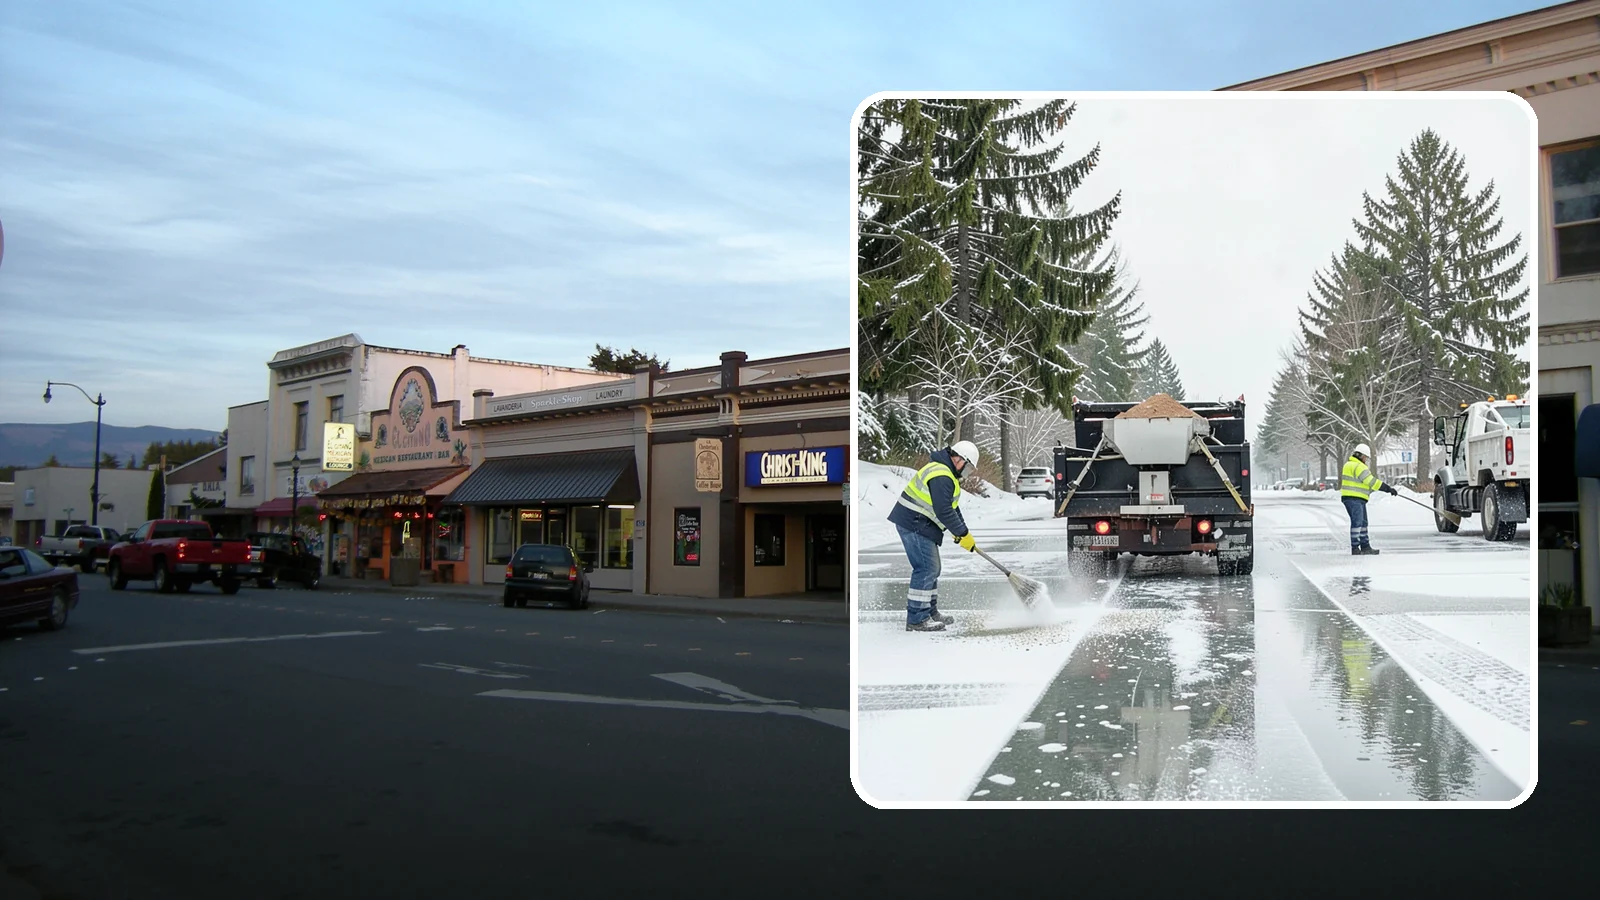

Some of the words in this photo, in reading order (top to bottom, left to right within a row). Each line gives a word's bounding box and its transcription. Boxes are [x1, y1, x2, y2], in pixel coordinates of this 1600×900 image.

[596, 389, 624, 400] LAUNDRY
[493, 402, 523, 412] LAVANDERIA
[530, 397, 561, 409] Sparkle
[562, 394, 582, 406] Shop
[373, 455, 396, 464] MEXICAN
[397, 452, 433, 462] RESTAURANT
[438, 450, 450, 459] BAR
[761, 452, 797, 478] CHRIST
[799, 450, 828, 476] KING
[696, 481, 709, 489] Coffee
[710, 481, 722, 489] House
